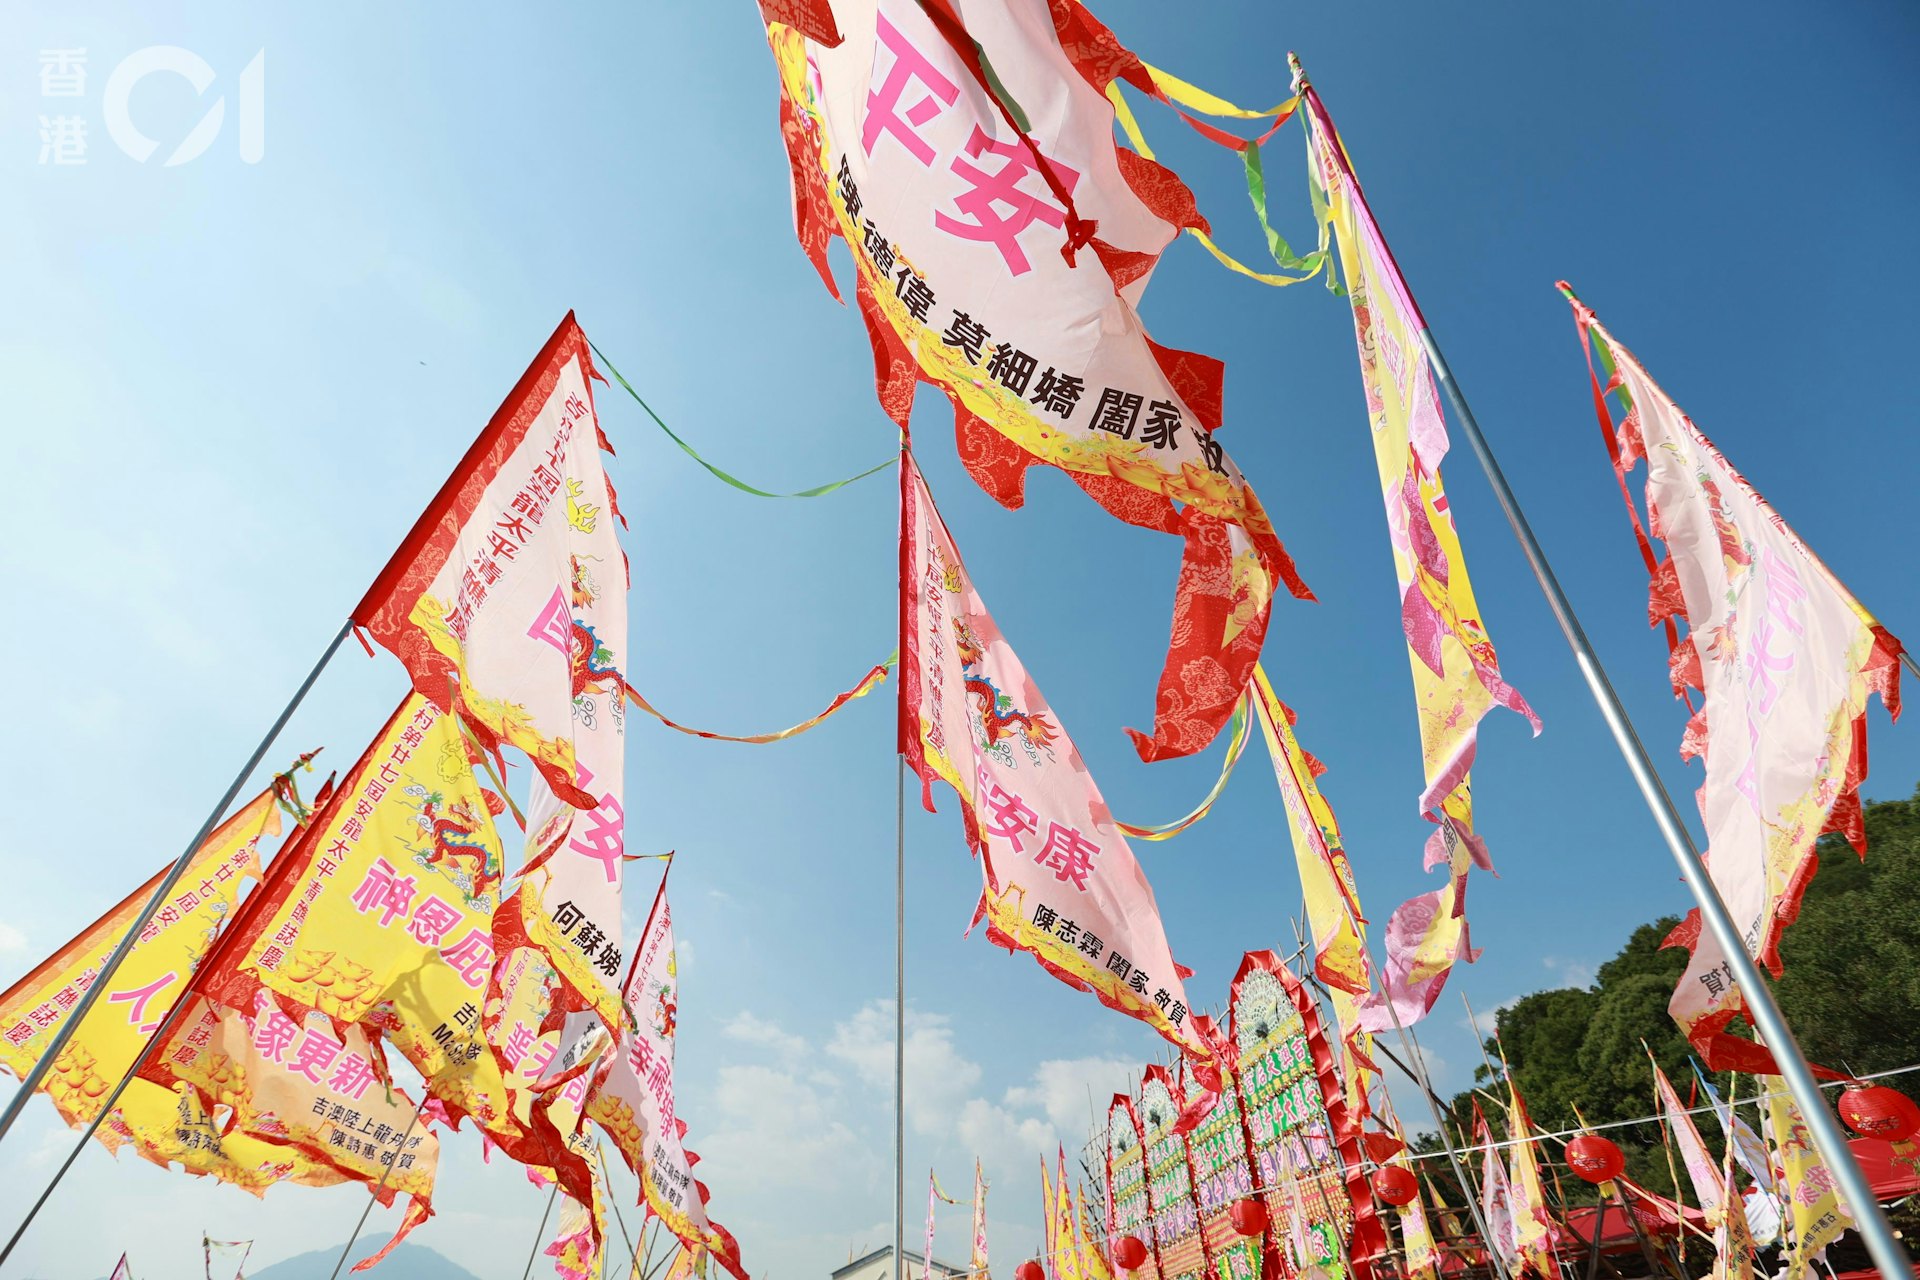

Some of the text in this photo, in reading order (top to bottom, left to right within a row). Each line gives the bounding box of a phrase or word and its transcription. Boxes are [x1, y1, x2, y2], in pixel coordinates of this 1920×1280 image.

[862, 10, 1081, 277] 平安
[836, 153, 937, 324] 陳德偉
[944, 308, 1085, 420] 莫細嬌
[1089, 387, 1183, 453] 闔家
[980, 765, 1101, 892] 安康
[1032, 903, 1187, 1028] 陳志霖 闔家 敬賀
